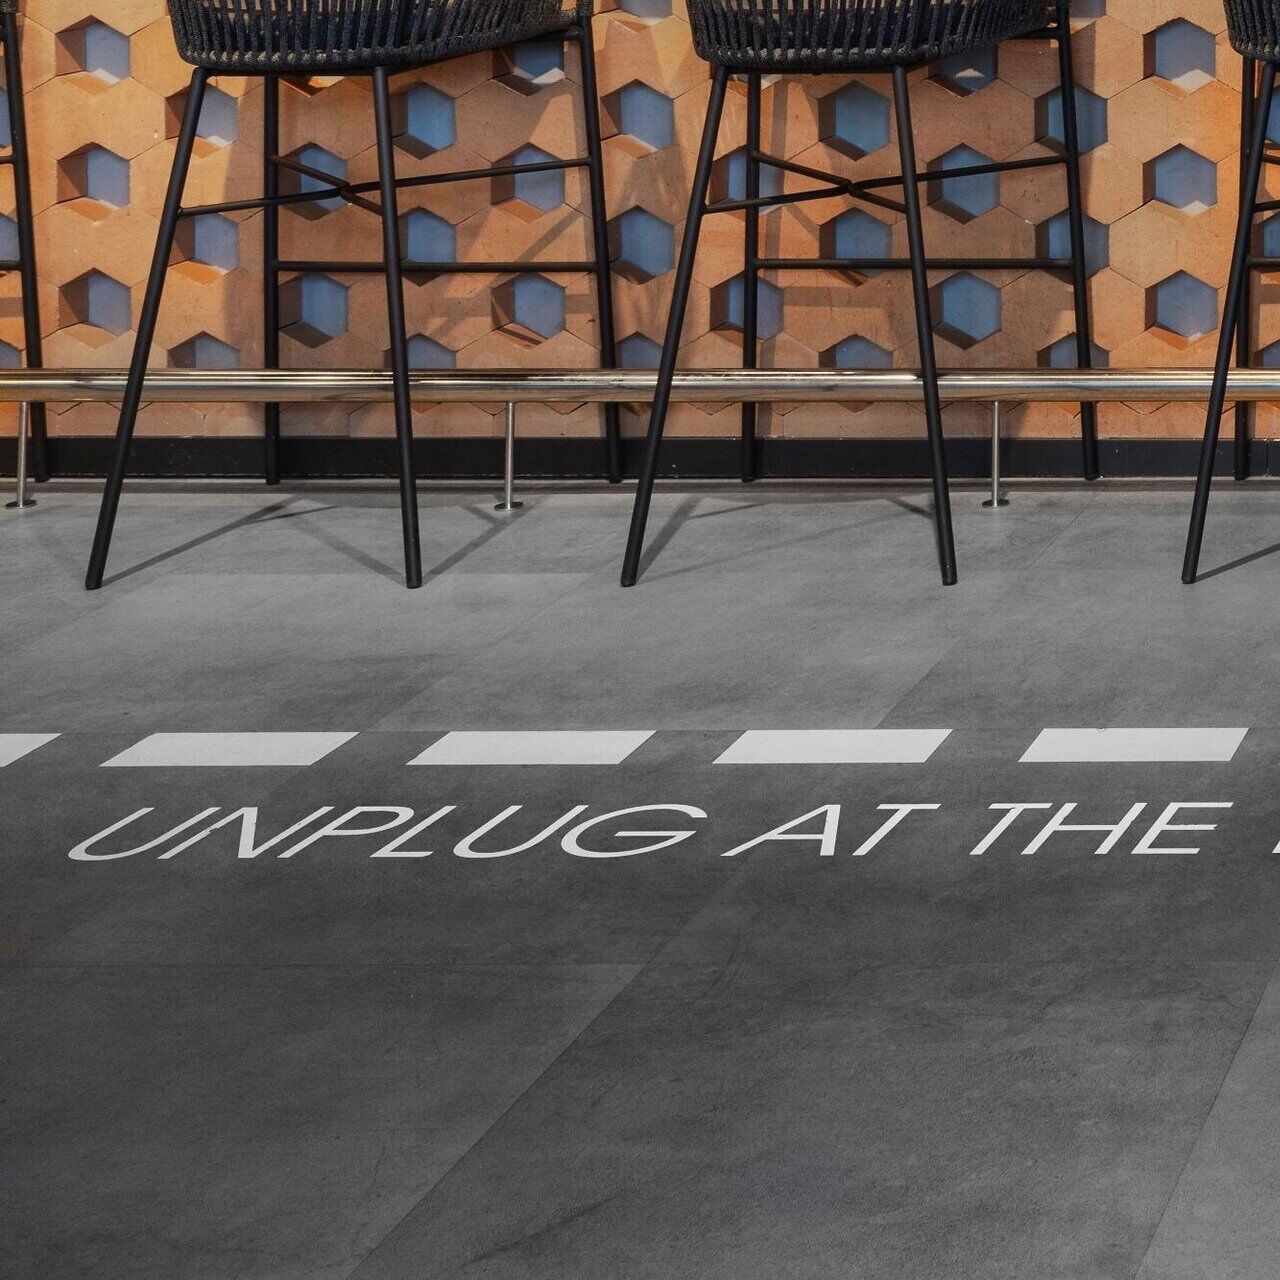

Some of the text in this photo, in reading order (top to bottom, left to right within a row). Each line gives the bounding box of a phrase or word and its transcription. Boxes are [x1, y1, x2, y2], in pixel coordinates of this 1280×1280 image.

[67, 803, 708, 862] UNPLUG
[720, 803, 940, 858] AT
[969, 802, 1234, 856] THE
